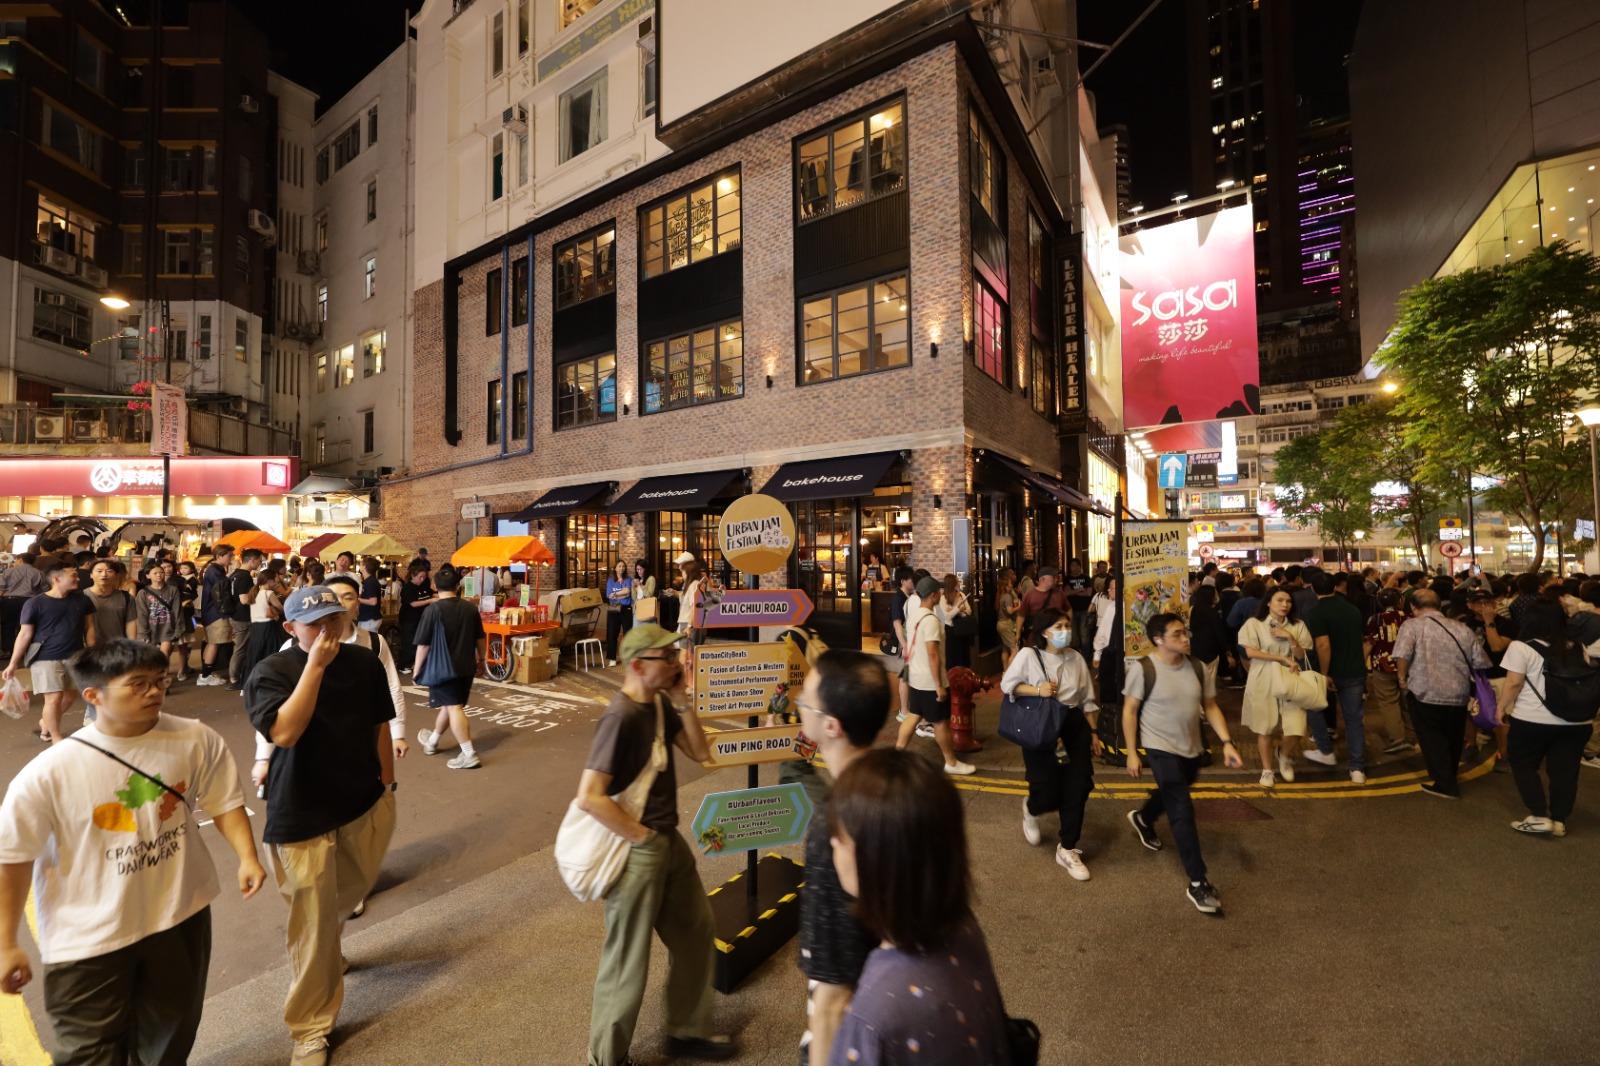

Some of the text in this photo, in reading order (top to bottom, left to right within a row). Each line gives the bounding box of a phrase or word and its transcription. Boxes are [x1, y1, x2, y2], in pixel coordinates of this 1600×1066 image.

[1064, 258, 1080, 409] LEATHER HEALER
[1158, 317, 1208, 346] 莎莎
[1139, 352, 1169, 364] making
[782, 474, 864, 488] bakehouse
[638, 488, 699, 499] bakehouse
[726, 520, 759, 538] URBAN
[760, 516, 780, 533] JAM
[726, 534, 763, 551] FESTIVAL
[1125, 530, 1180, 548] URBAN JAM
[1125, 545, 1164, 560] FESTIVAL
[721, 601, 788, 614] KAI CHIU ROAD
[700, 651, 747, 660] #UrbanCityBeats
[709, 662, 785, 674] Fusion of Eastern & Western
[709, 674, 779, 686] Instrumental Performance
[709, 688, 764, 699] Music & Dance Show
[709, 700, 764, 712] Street Art Programs
[480, 711, 560, 733] LOOK
[717, 737, 791, 755] YUN PING ROAD
[727, 797, 781, 809] #UrbanFlavours
[106, 823, 186, 860] CRAFTWORKS
